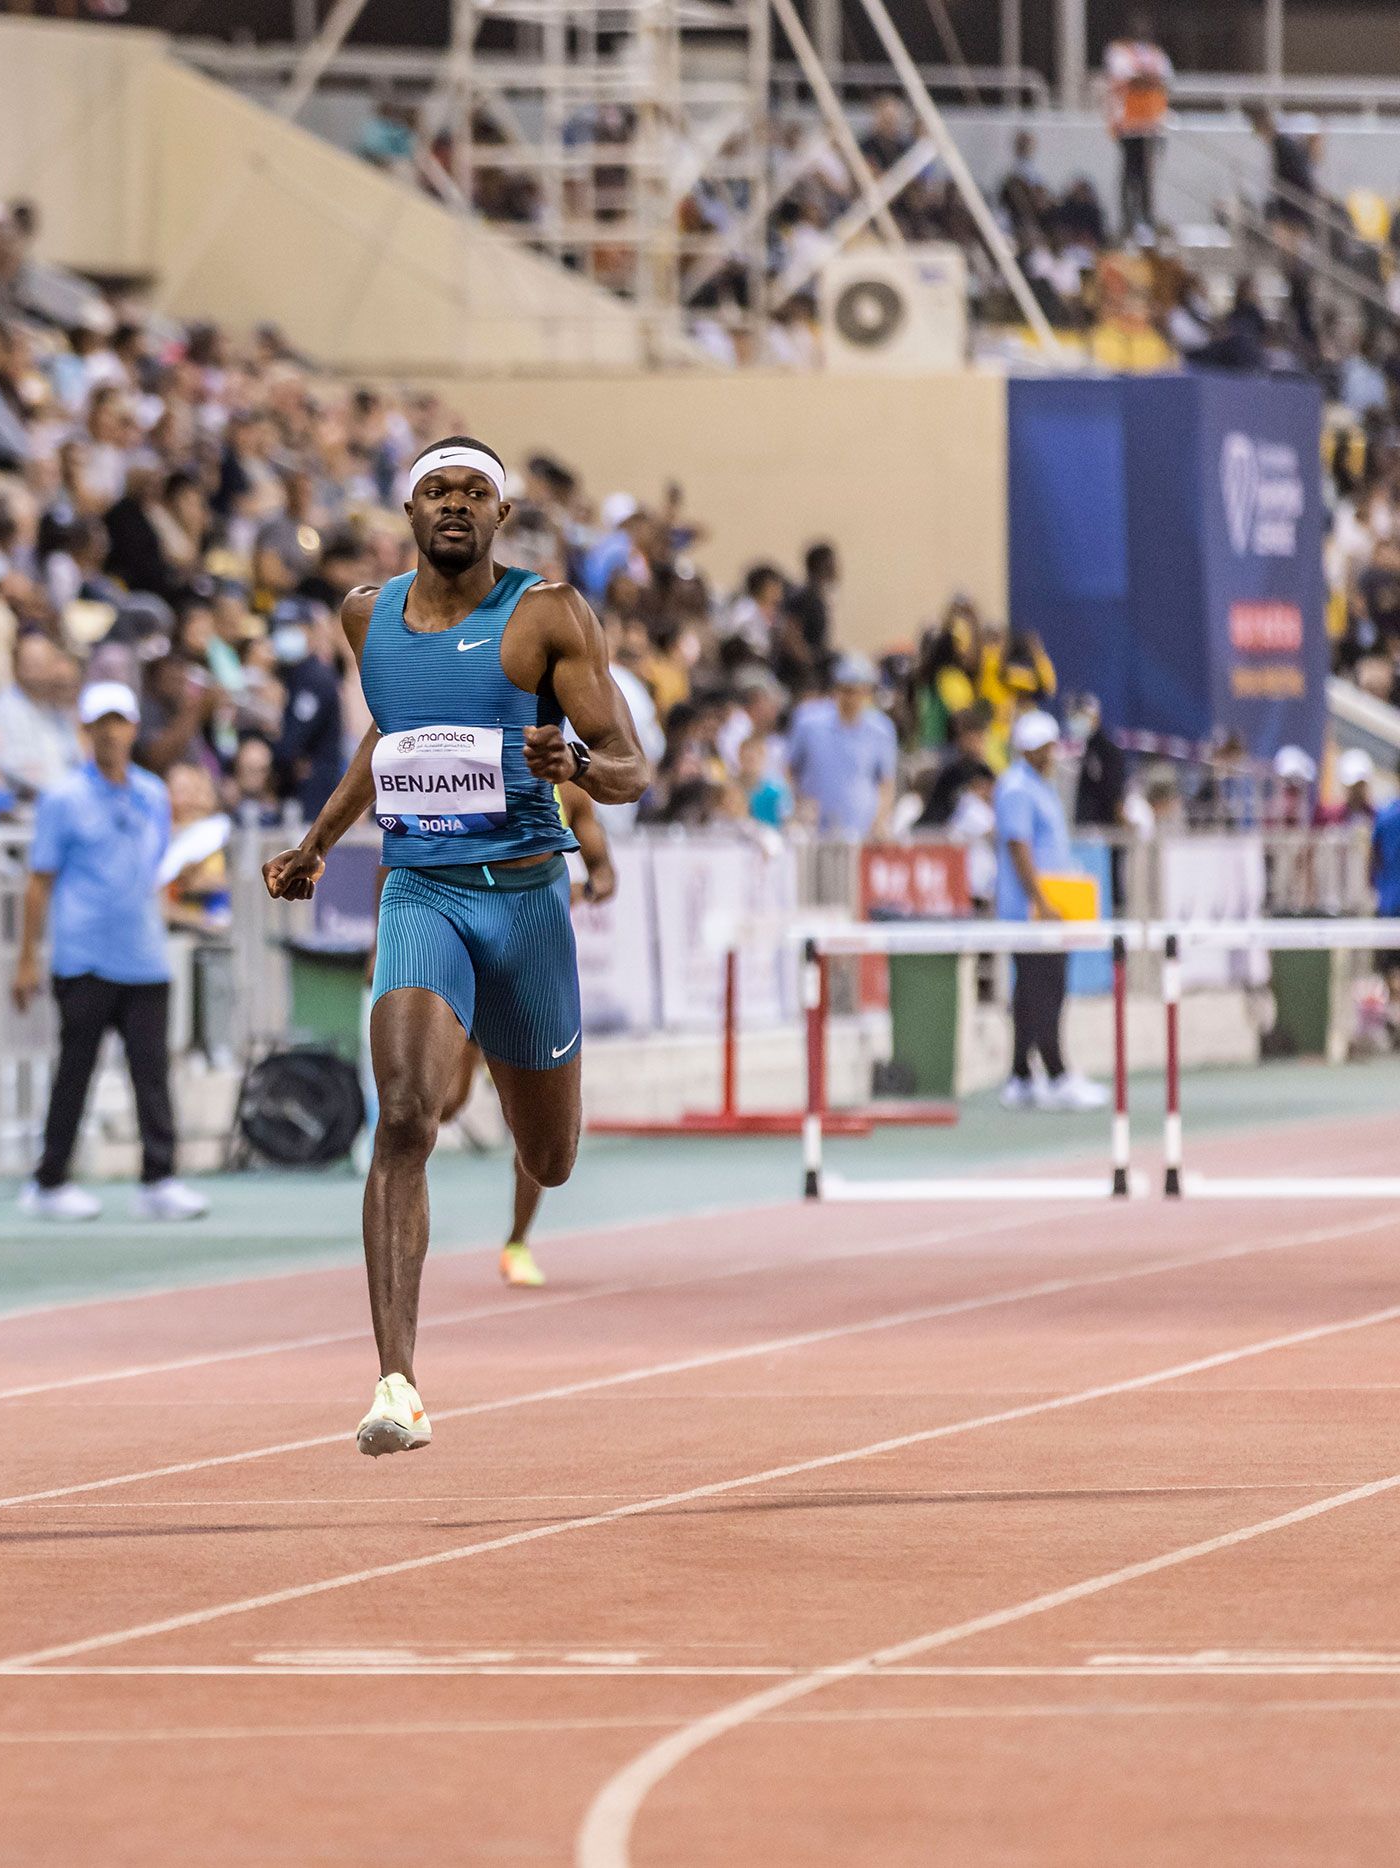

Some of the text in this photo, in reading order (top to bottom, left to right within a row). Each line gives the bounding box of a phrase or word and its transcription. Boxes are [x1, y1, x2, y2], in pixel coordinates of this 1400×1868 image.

[416, 731, 476, 747] manateq
[379, 772, 497, 793] BENJAMIN
[419, 818, 465, 832] DOHA
